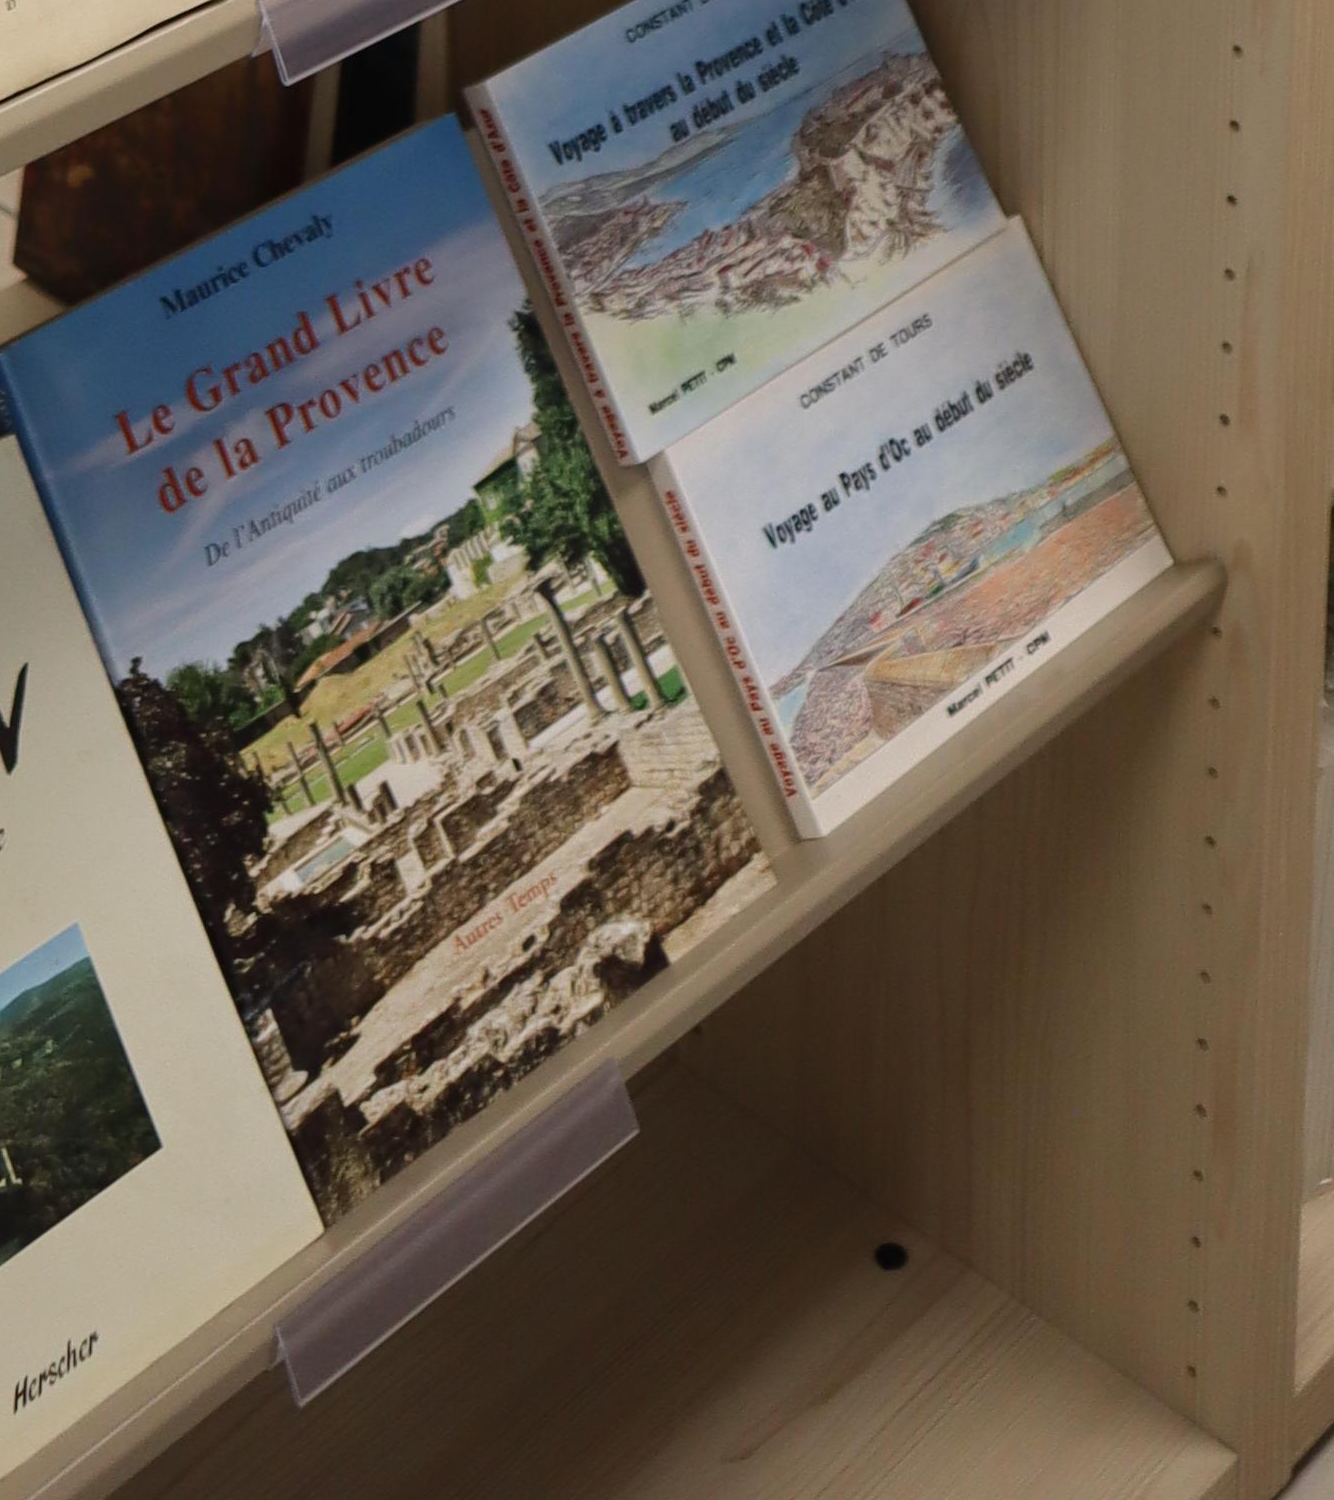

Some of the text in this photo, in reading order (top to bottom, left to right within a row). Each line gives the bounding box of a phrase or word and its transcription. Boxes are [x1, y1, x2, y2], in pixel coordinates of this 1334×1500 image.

[114, 252, 437, 455] Le Grand Livre
[159, 211, 336, 320] Maurice Chevaly
[156, 321, 450, 516] de la Provence
[204, 402, 456, 569] De l'Antiquité aux troubadours
[762, 351, 1035, 551] Voyage au Pays d'Oc au début du siècle
[11, 1328, 101, 1416] Herscher
